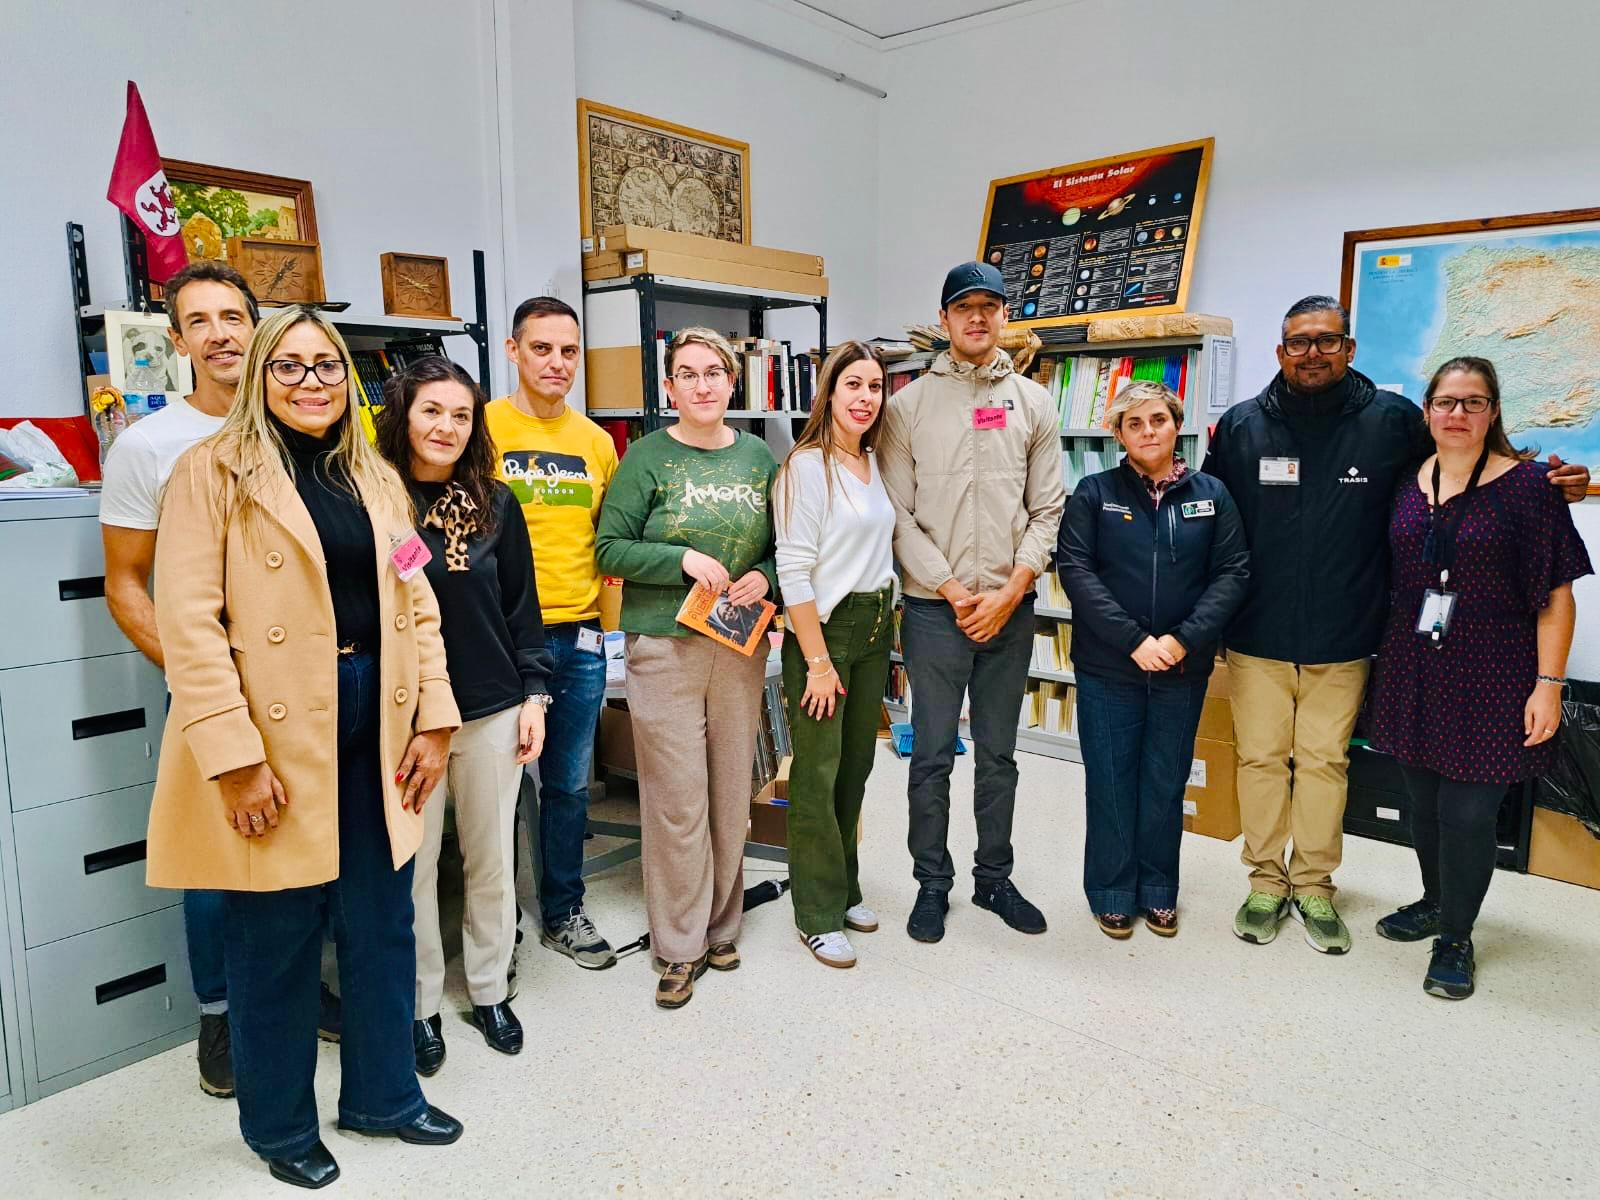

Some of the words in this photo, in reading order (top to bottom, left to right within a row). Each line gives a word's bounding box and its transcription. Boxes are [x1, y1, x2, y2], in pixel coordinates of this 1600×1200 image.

[1053, 179, 1063, 189] El
[1065, 172, 1104, 187] Sistema
[1107, 166, 1135, 178] Solar
[502, 458, 545, 486] Pepe
[546, 462, 593, 488] Jeans
[680, 479, 765, 514] AMORE
